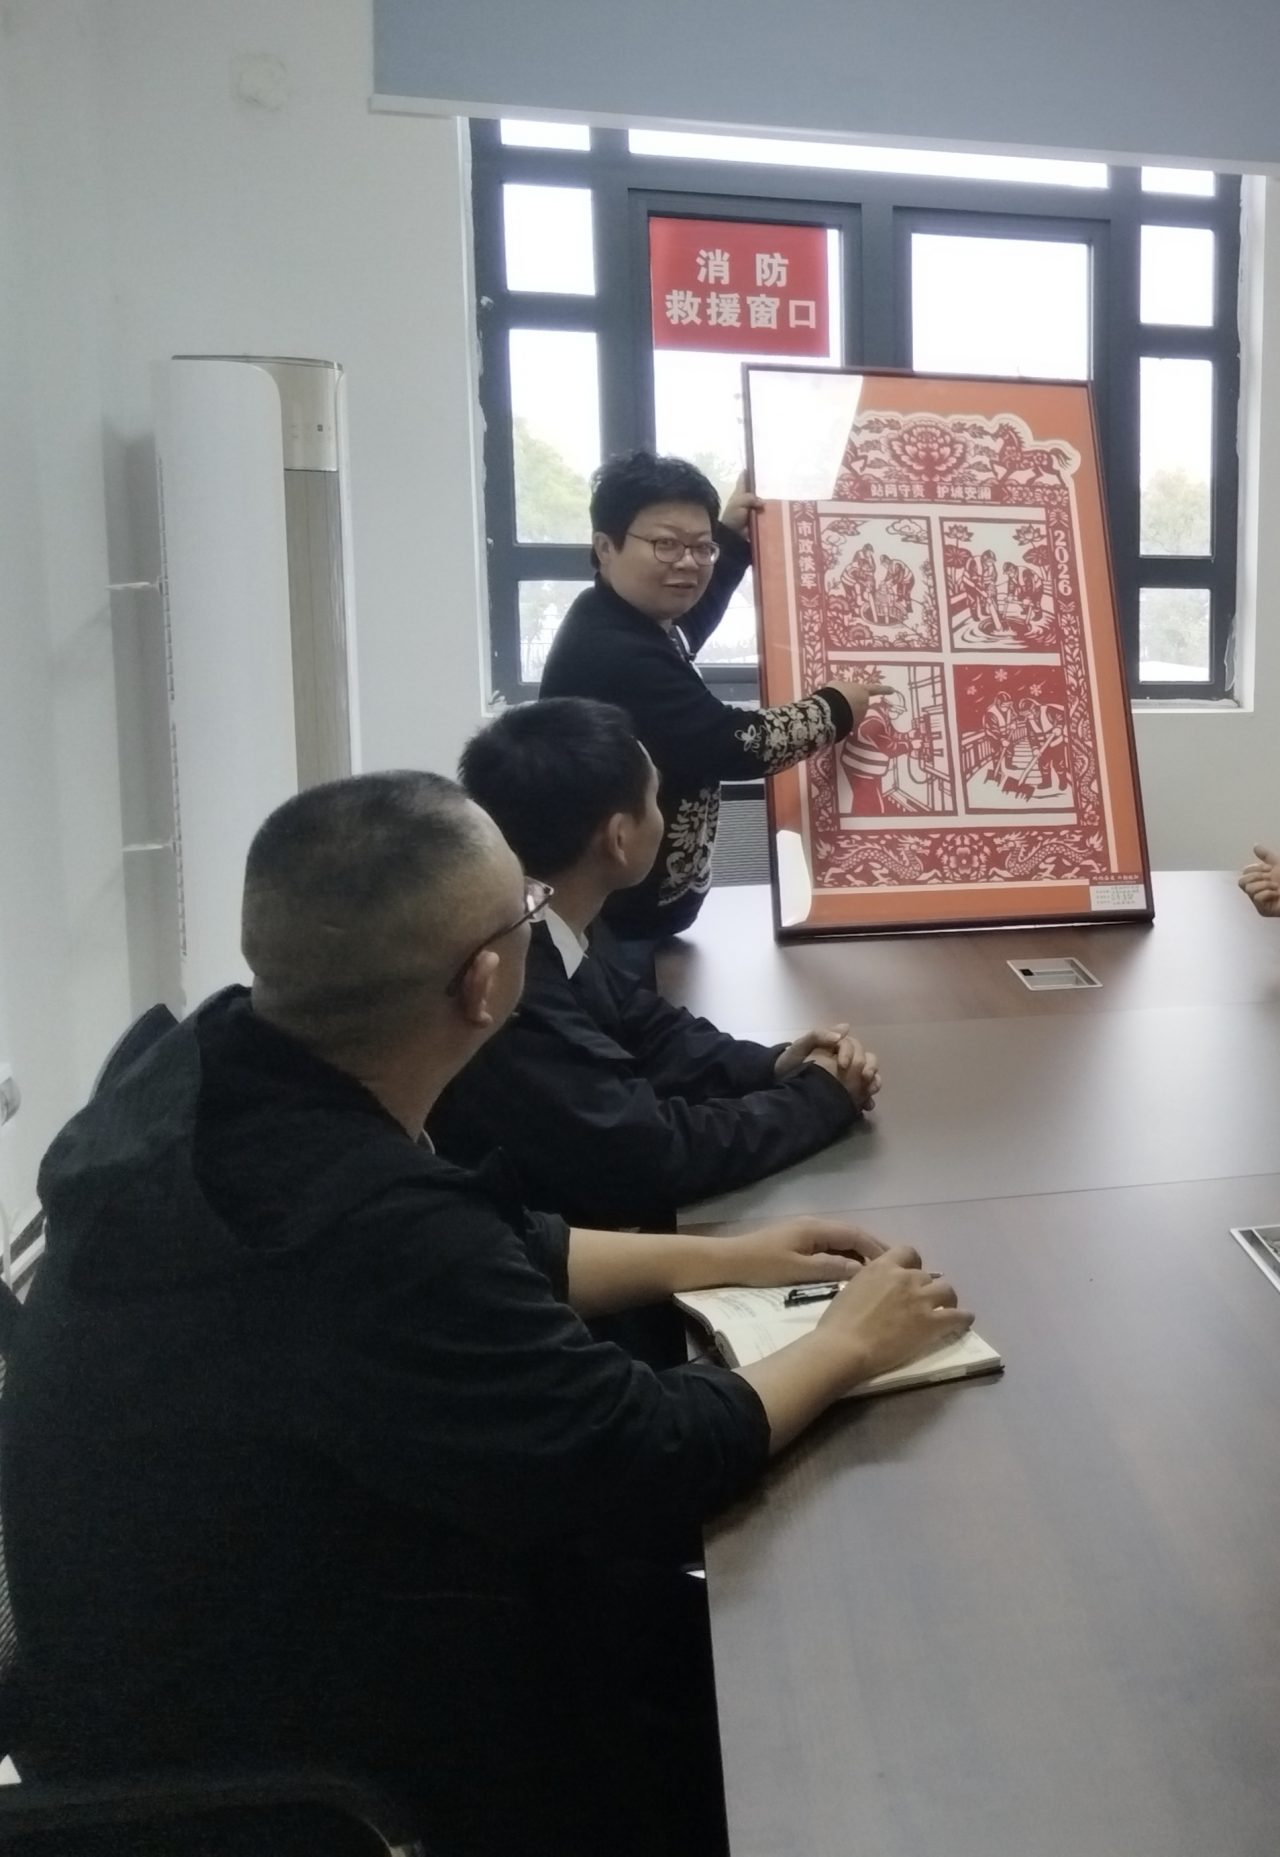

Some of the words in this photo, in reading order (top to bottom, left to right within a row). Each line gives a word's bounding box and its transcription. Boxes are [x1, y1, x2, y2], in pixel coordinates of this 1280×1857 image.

[695, 248, 789, 288] 消防
[665, 289, 816, 330] 救援窗口
[1053, 529, 1073, 597] 2026
